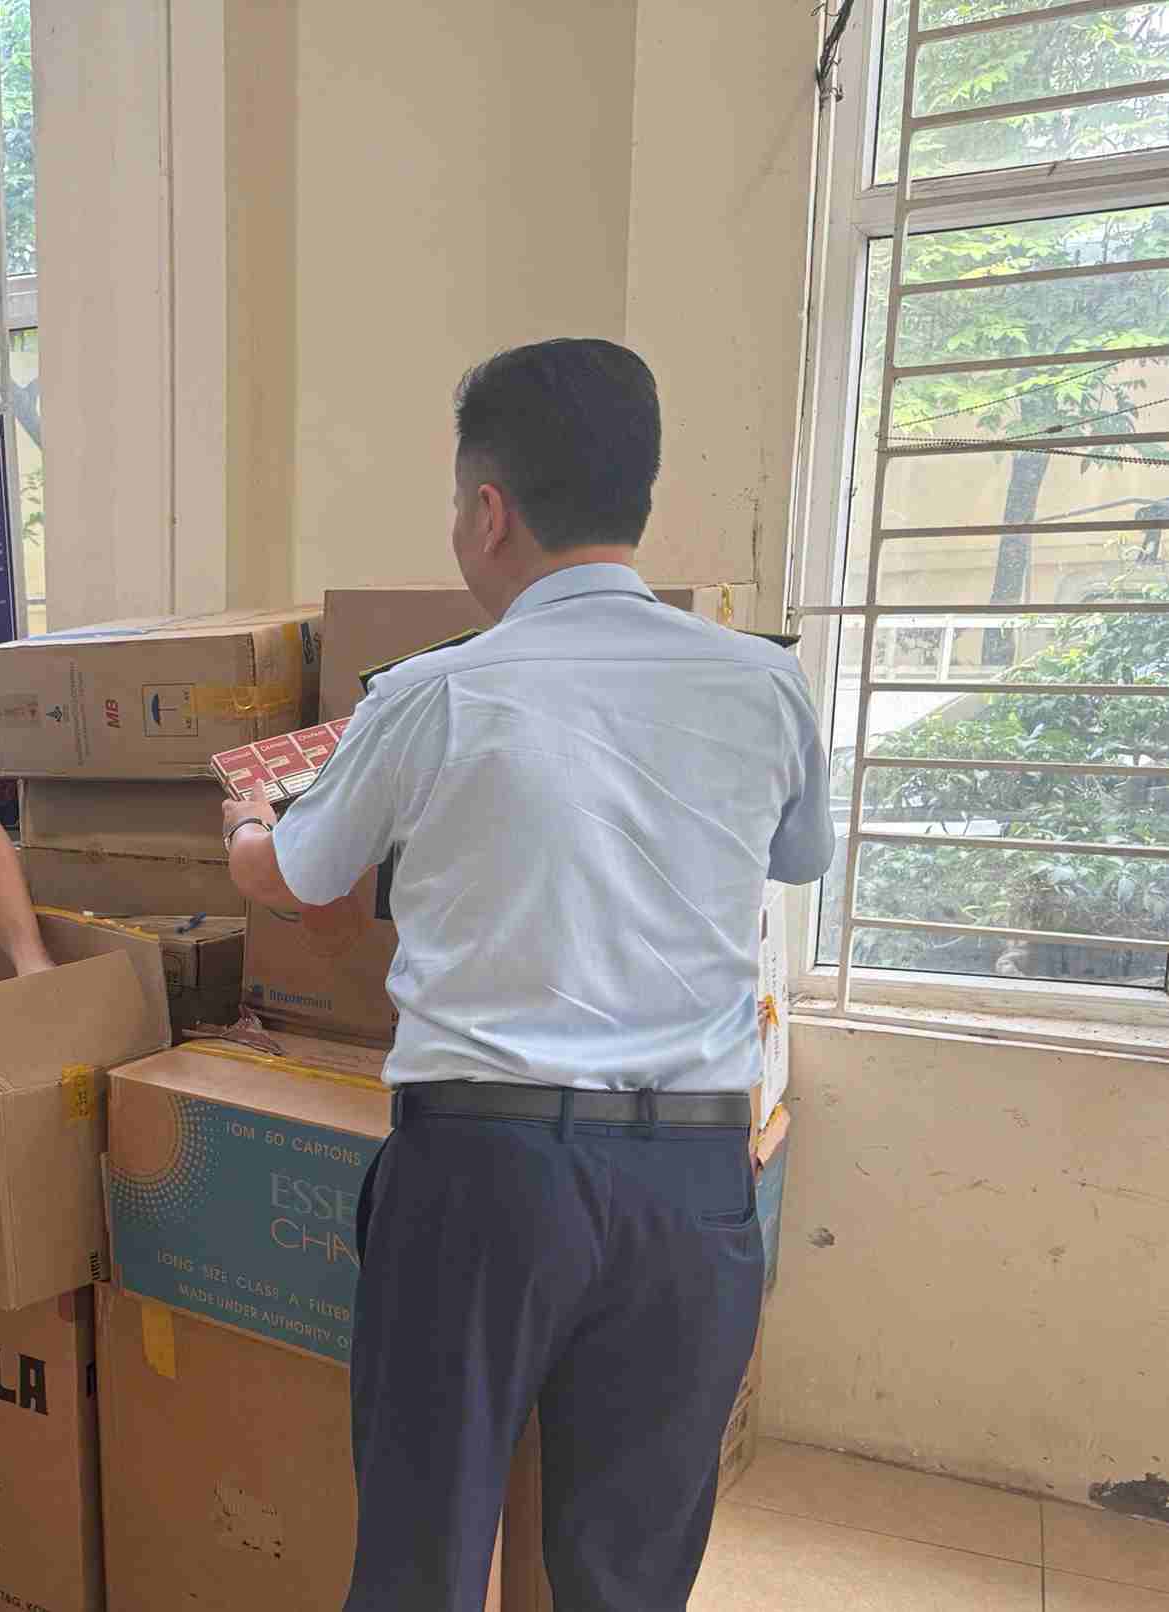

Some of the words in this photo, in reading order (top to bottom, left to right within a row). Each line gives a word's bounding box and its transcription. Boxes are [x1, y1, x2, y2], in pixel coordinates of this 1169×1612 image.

[291, 1136, 361, 1167] CARTONS
[270, 1170, 358, 1228] ESSE
[270, 1216, 361, 1270] CHA
[158, 1248, 194, 1273] LONG
[236, 1273, 279, 1299] CLASS
[288, 1293, 300, 1307] A
[178, 1283, 217, 1305] MADE
[217, 1296, 258, 1320] UNDER
[261, 1311, 331, 1342] AUTHORITY
[337, 1334, 351, 1350] O
